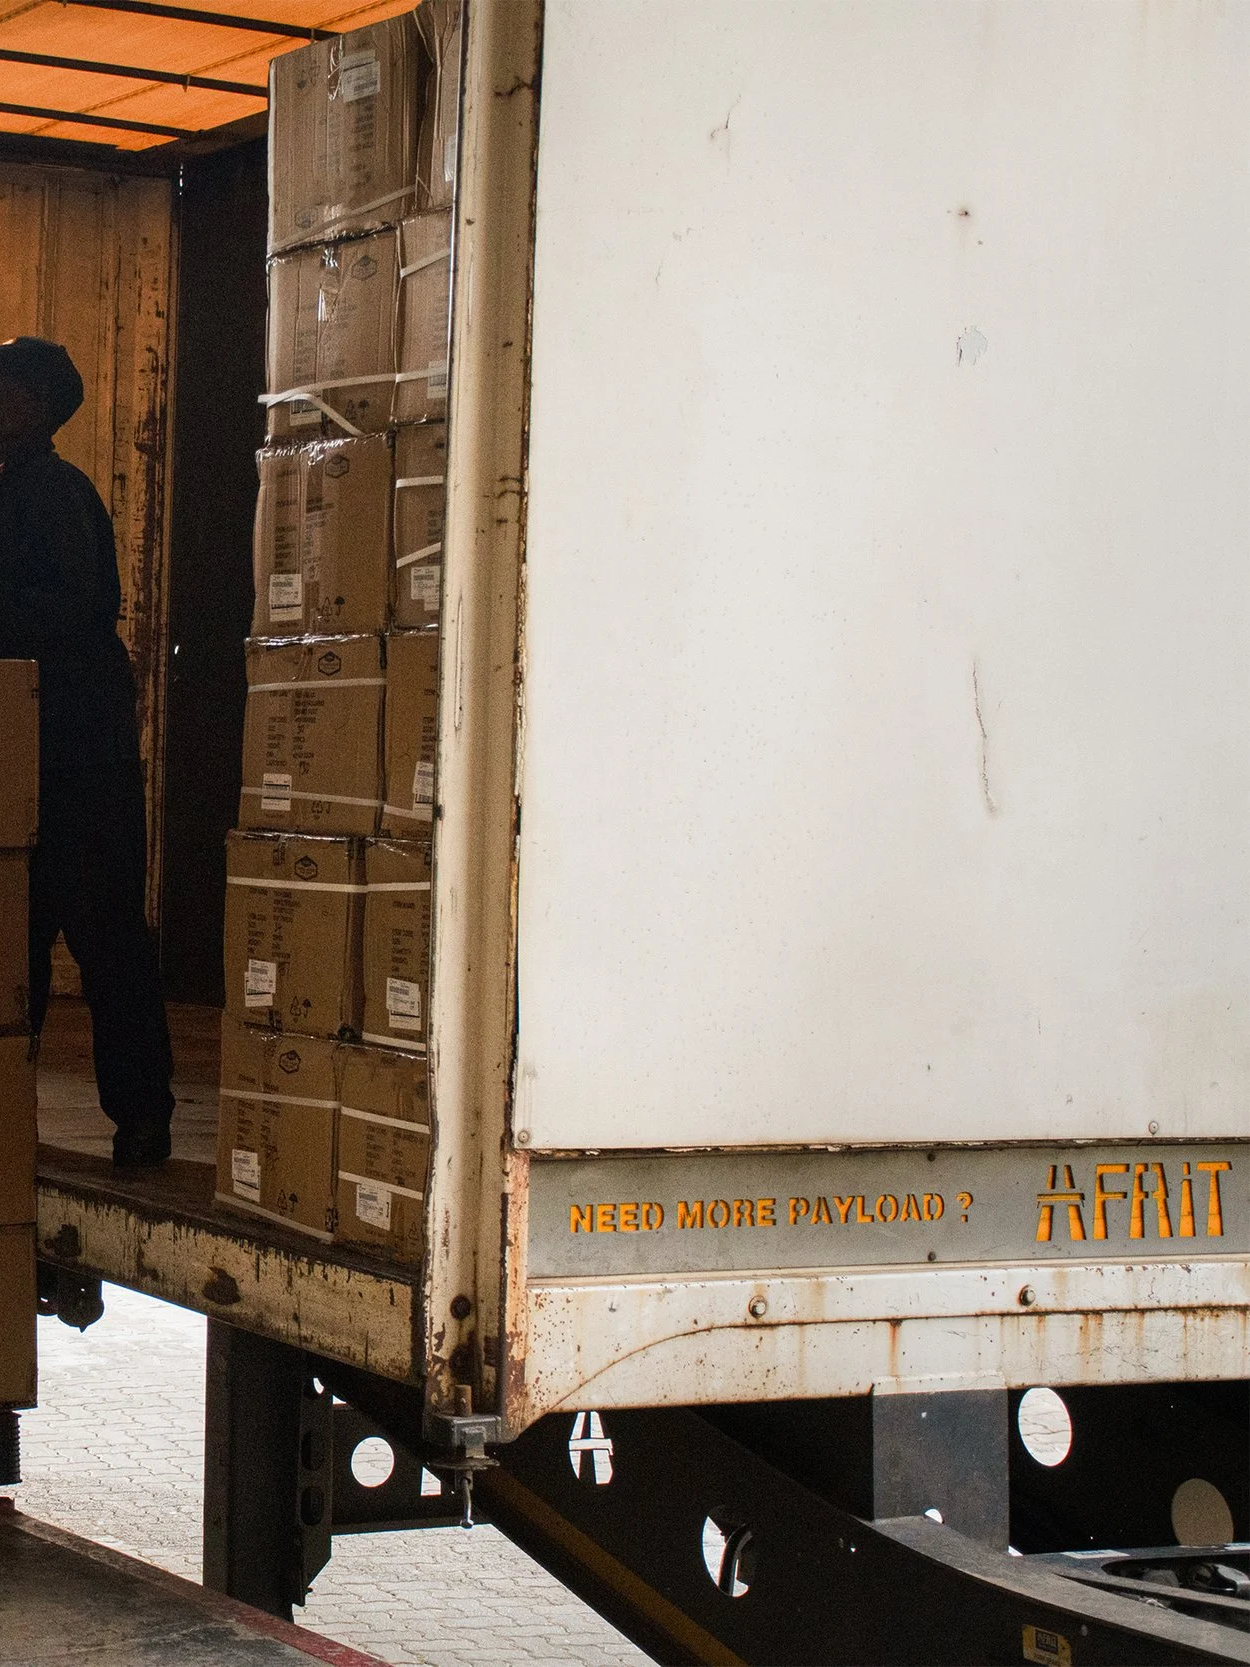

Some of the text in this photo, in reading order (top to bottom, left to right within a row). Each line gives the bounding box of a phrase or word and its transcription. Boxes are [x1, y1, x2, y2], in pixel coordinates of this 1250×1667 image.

[569, 1191, 974, 1233] NEED MORE PAYLOAD ?
